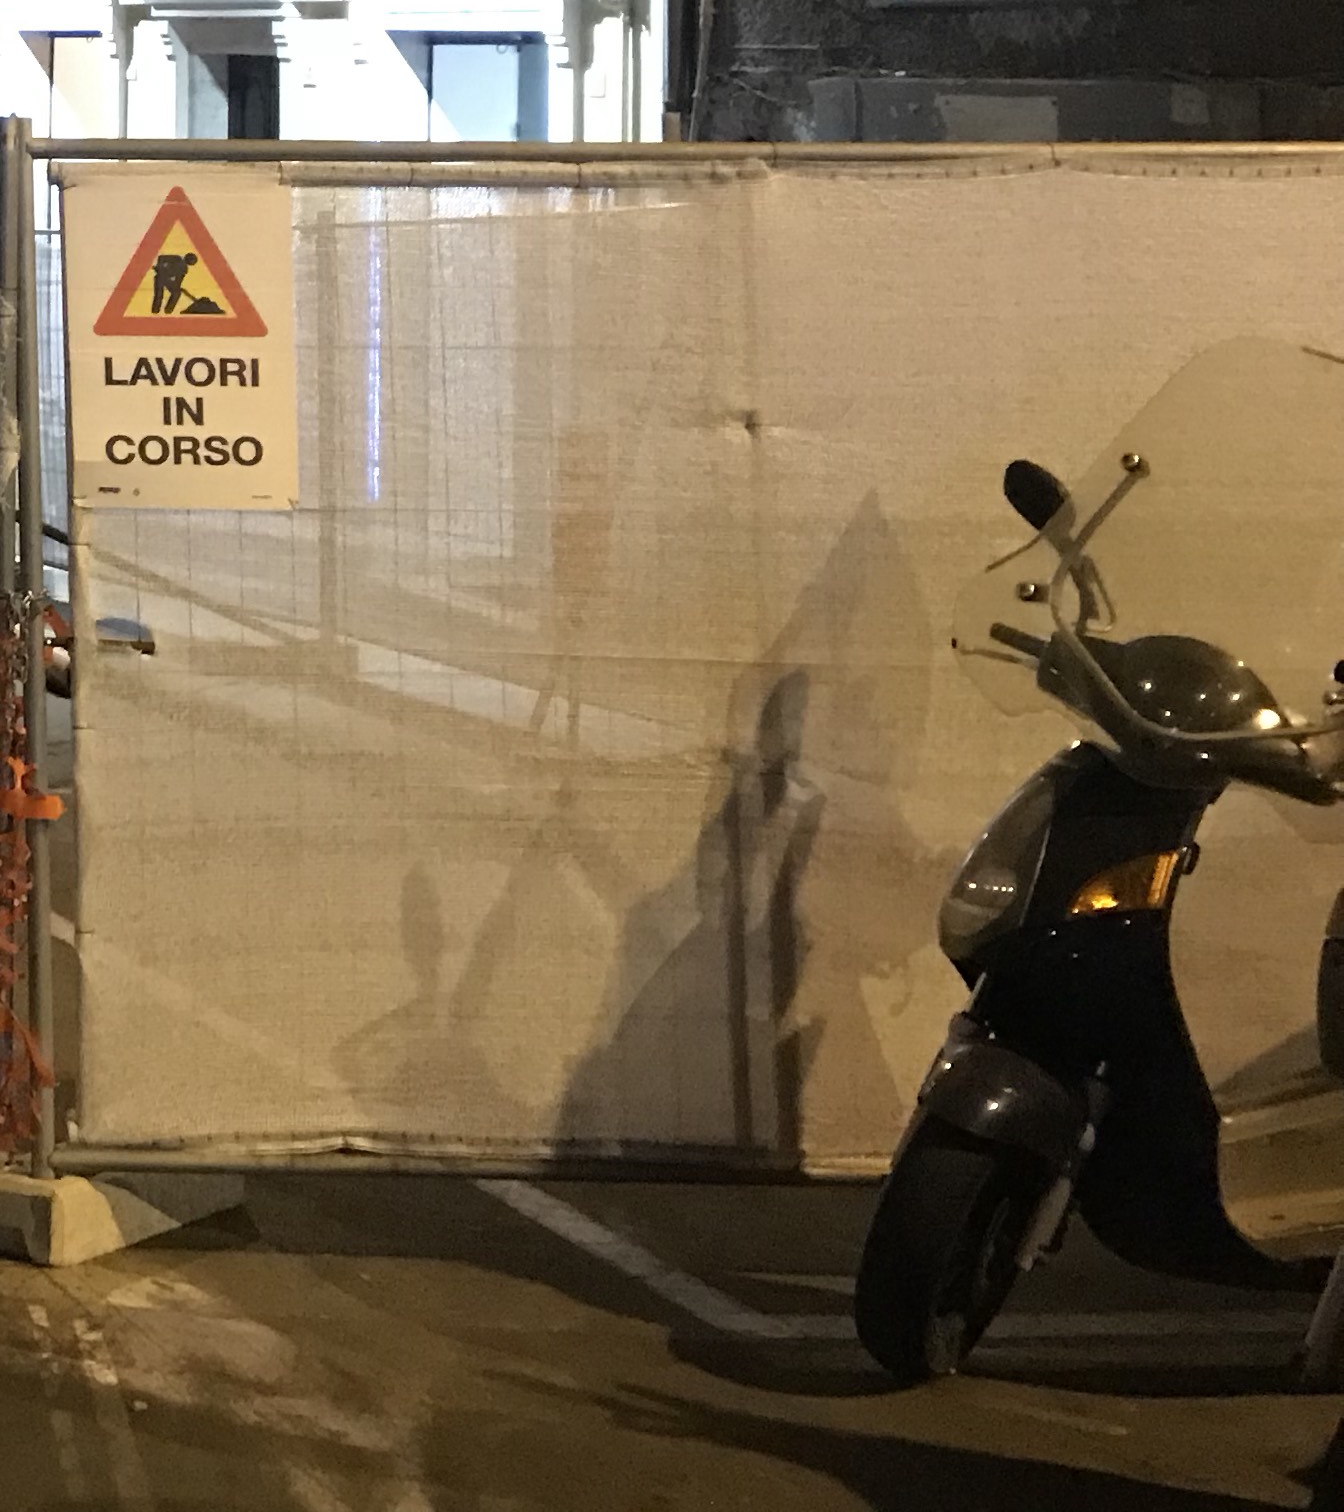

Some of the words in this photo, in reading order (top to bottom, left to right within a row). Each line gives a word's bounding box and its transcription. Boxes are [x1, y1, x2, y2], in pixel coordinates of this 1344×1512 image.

[104, 356, 260, 387] LAVORI
[162, 396, 205, 426] IN
[105, 434, 264, 466] CORSO
